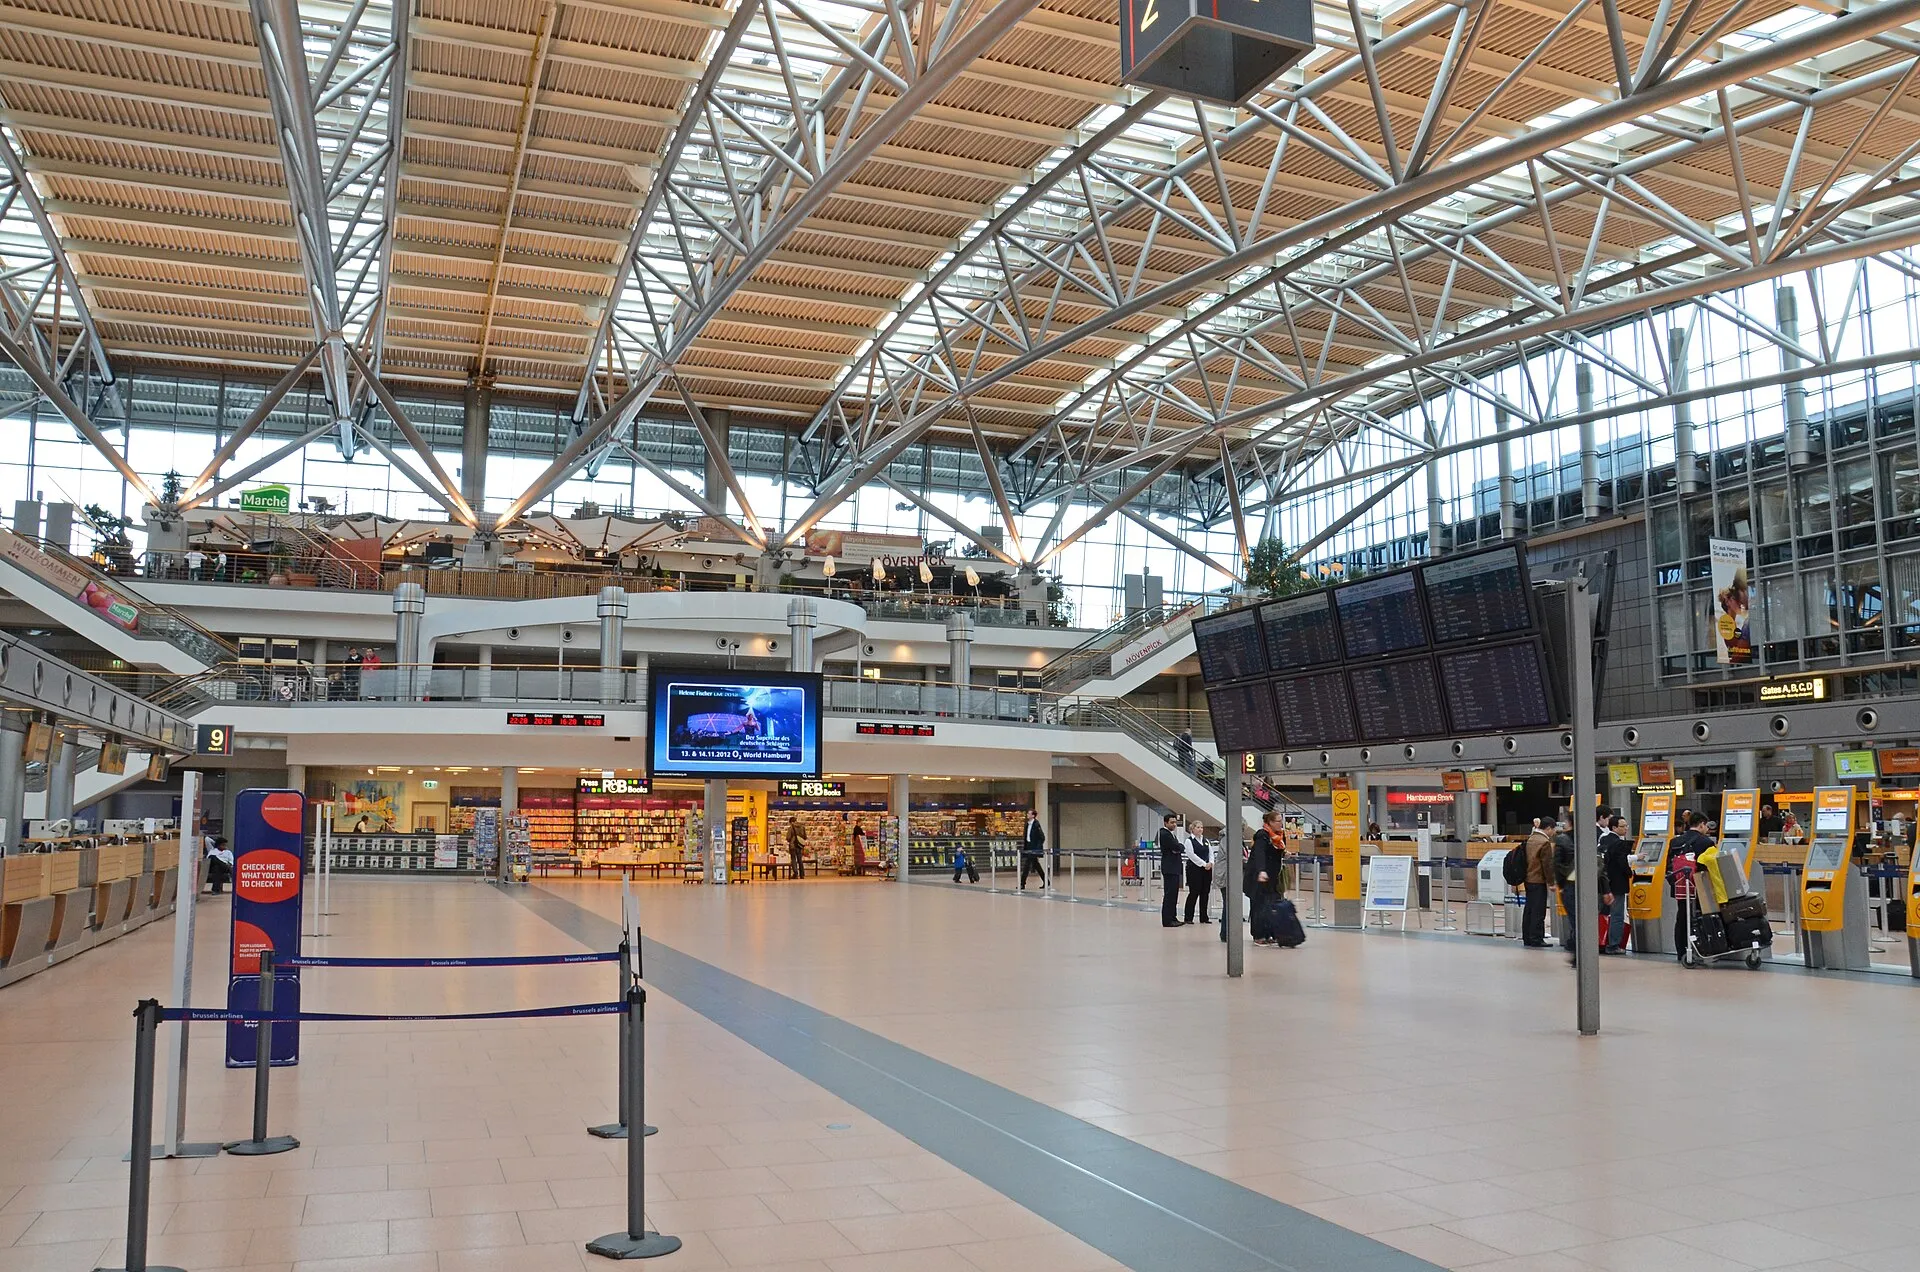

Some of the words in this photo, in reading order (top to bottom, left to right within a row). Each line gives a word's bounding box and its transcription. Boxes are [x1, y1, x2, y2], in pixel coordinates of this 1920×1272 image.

[244, 494, 288, 507] Marché
[12, 540, 81, 586] WILLKOMMEN
[870, 554, 946, 566] MÖVENPICK
[1125, 640, 1162, 665] MÖVENPICK
[1761, 686, 1781, 695] Gates
[210, 729, 224, 746] 9
[1246, 754, 1254, 768] 8
[602, 779, 627, 793] R&B
[801, 783, 823, 796] R&B
[1406, 794, 1437, 802] Hamburger
